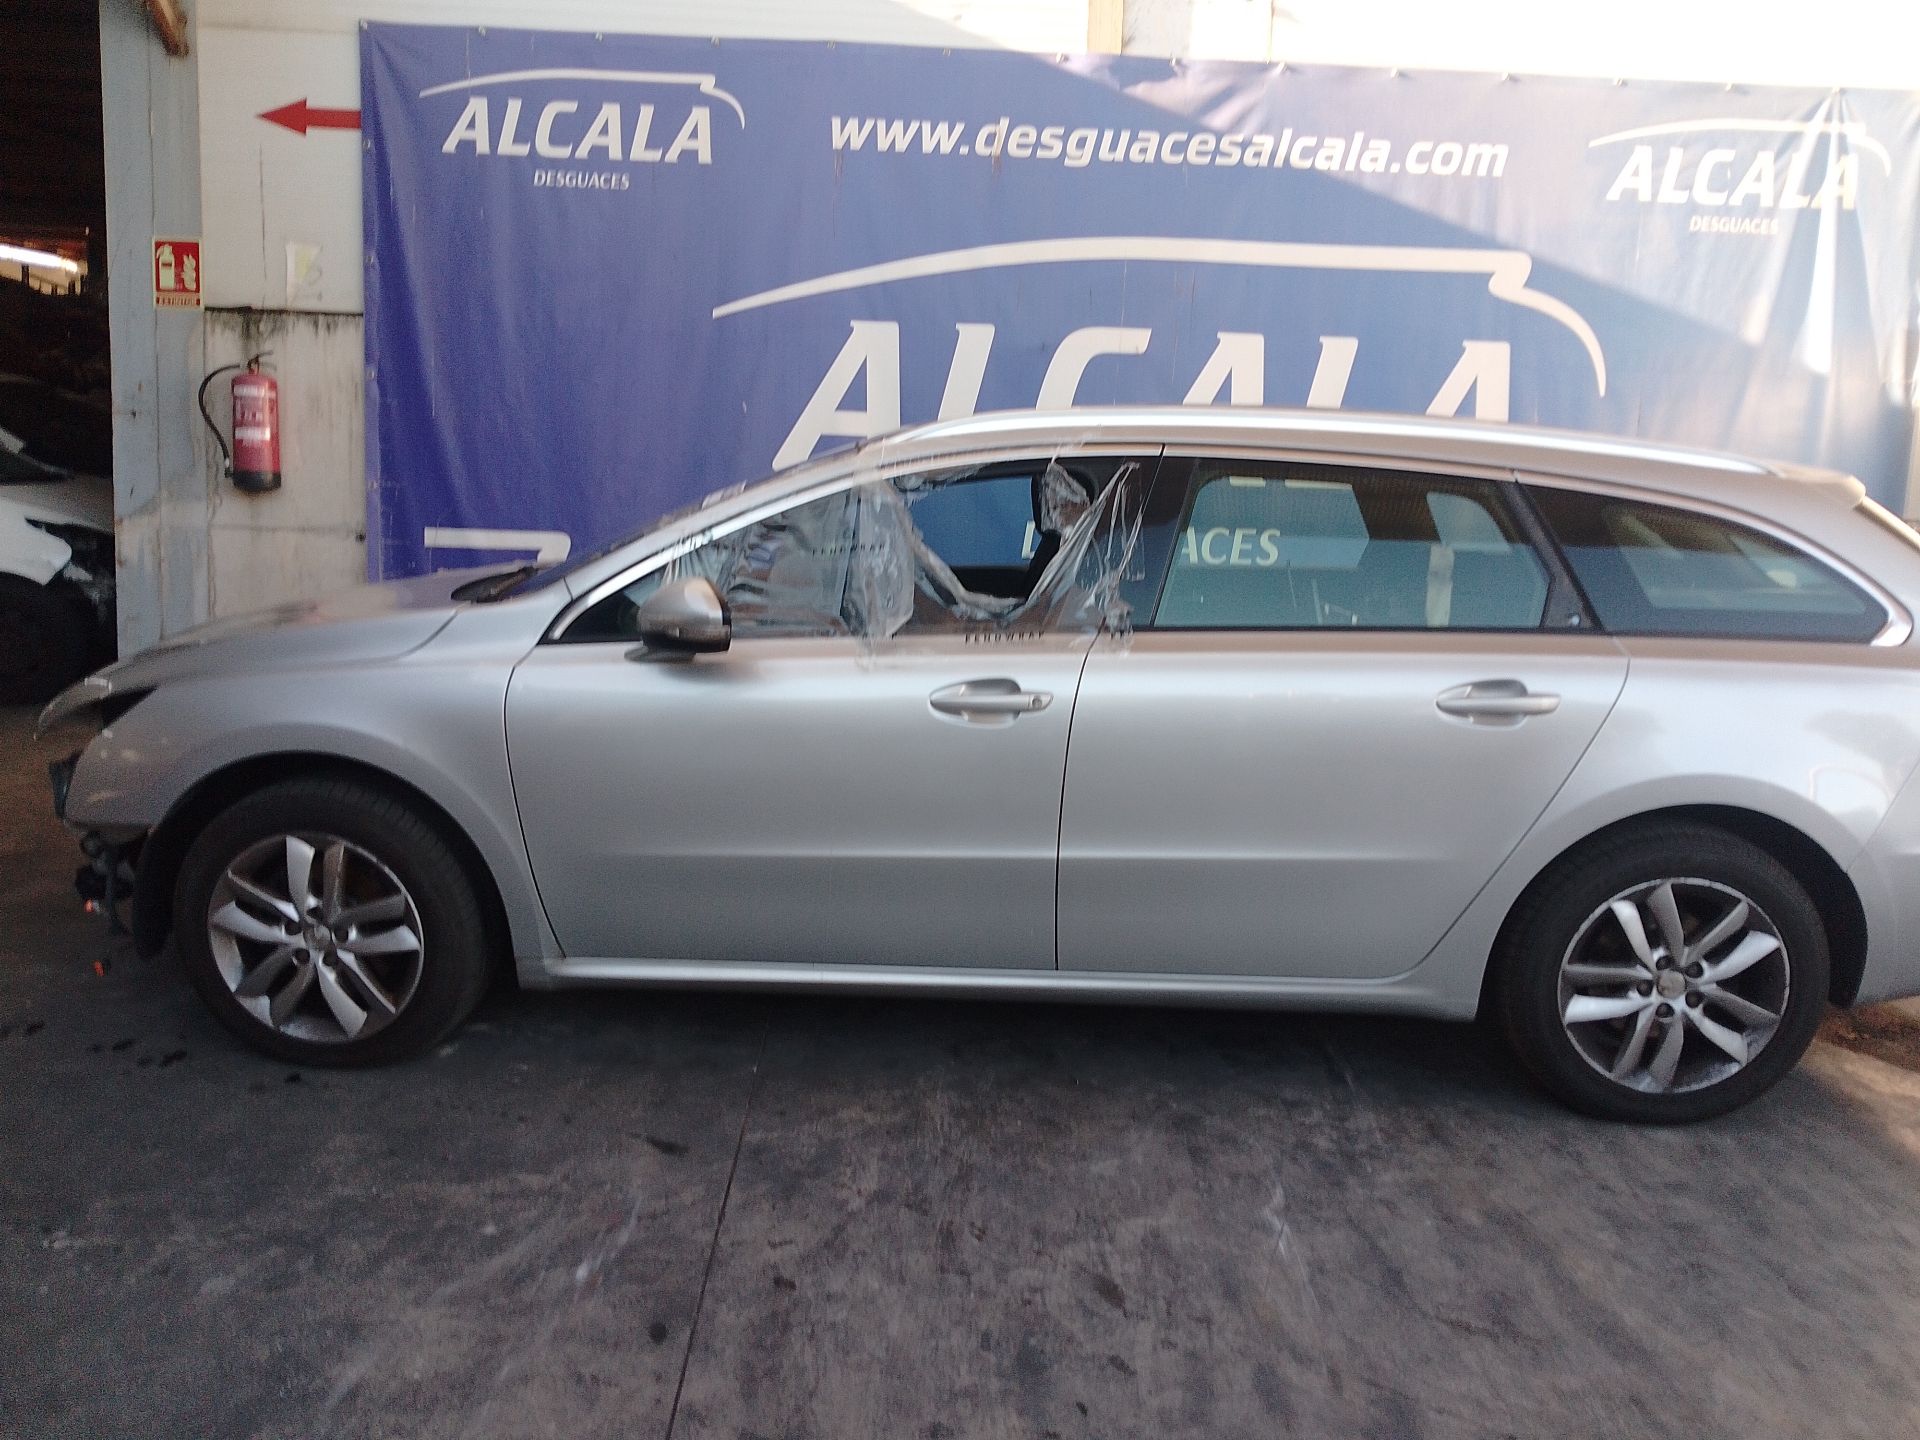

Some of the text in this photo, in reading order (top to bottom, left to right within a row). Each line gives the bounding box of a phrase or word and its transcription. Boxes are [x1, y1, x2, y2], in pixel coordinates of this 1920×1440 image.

[442, 95, 713, 164] ALCALA
[831, 116, 1509, 177] www.desguacesalcala.com
[533, 169, 630, 191] DESGUACES
[1606, 144, 1860, 210] ALCALA
[1689, 215, 1779, 235] DESGUACES
